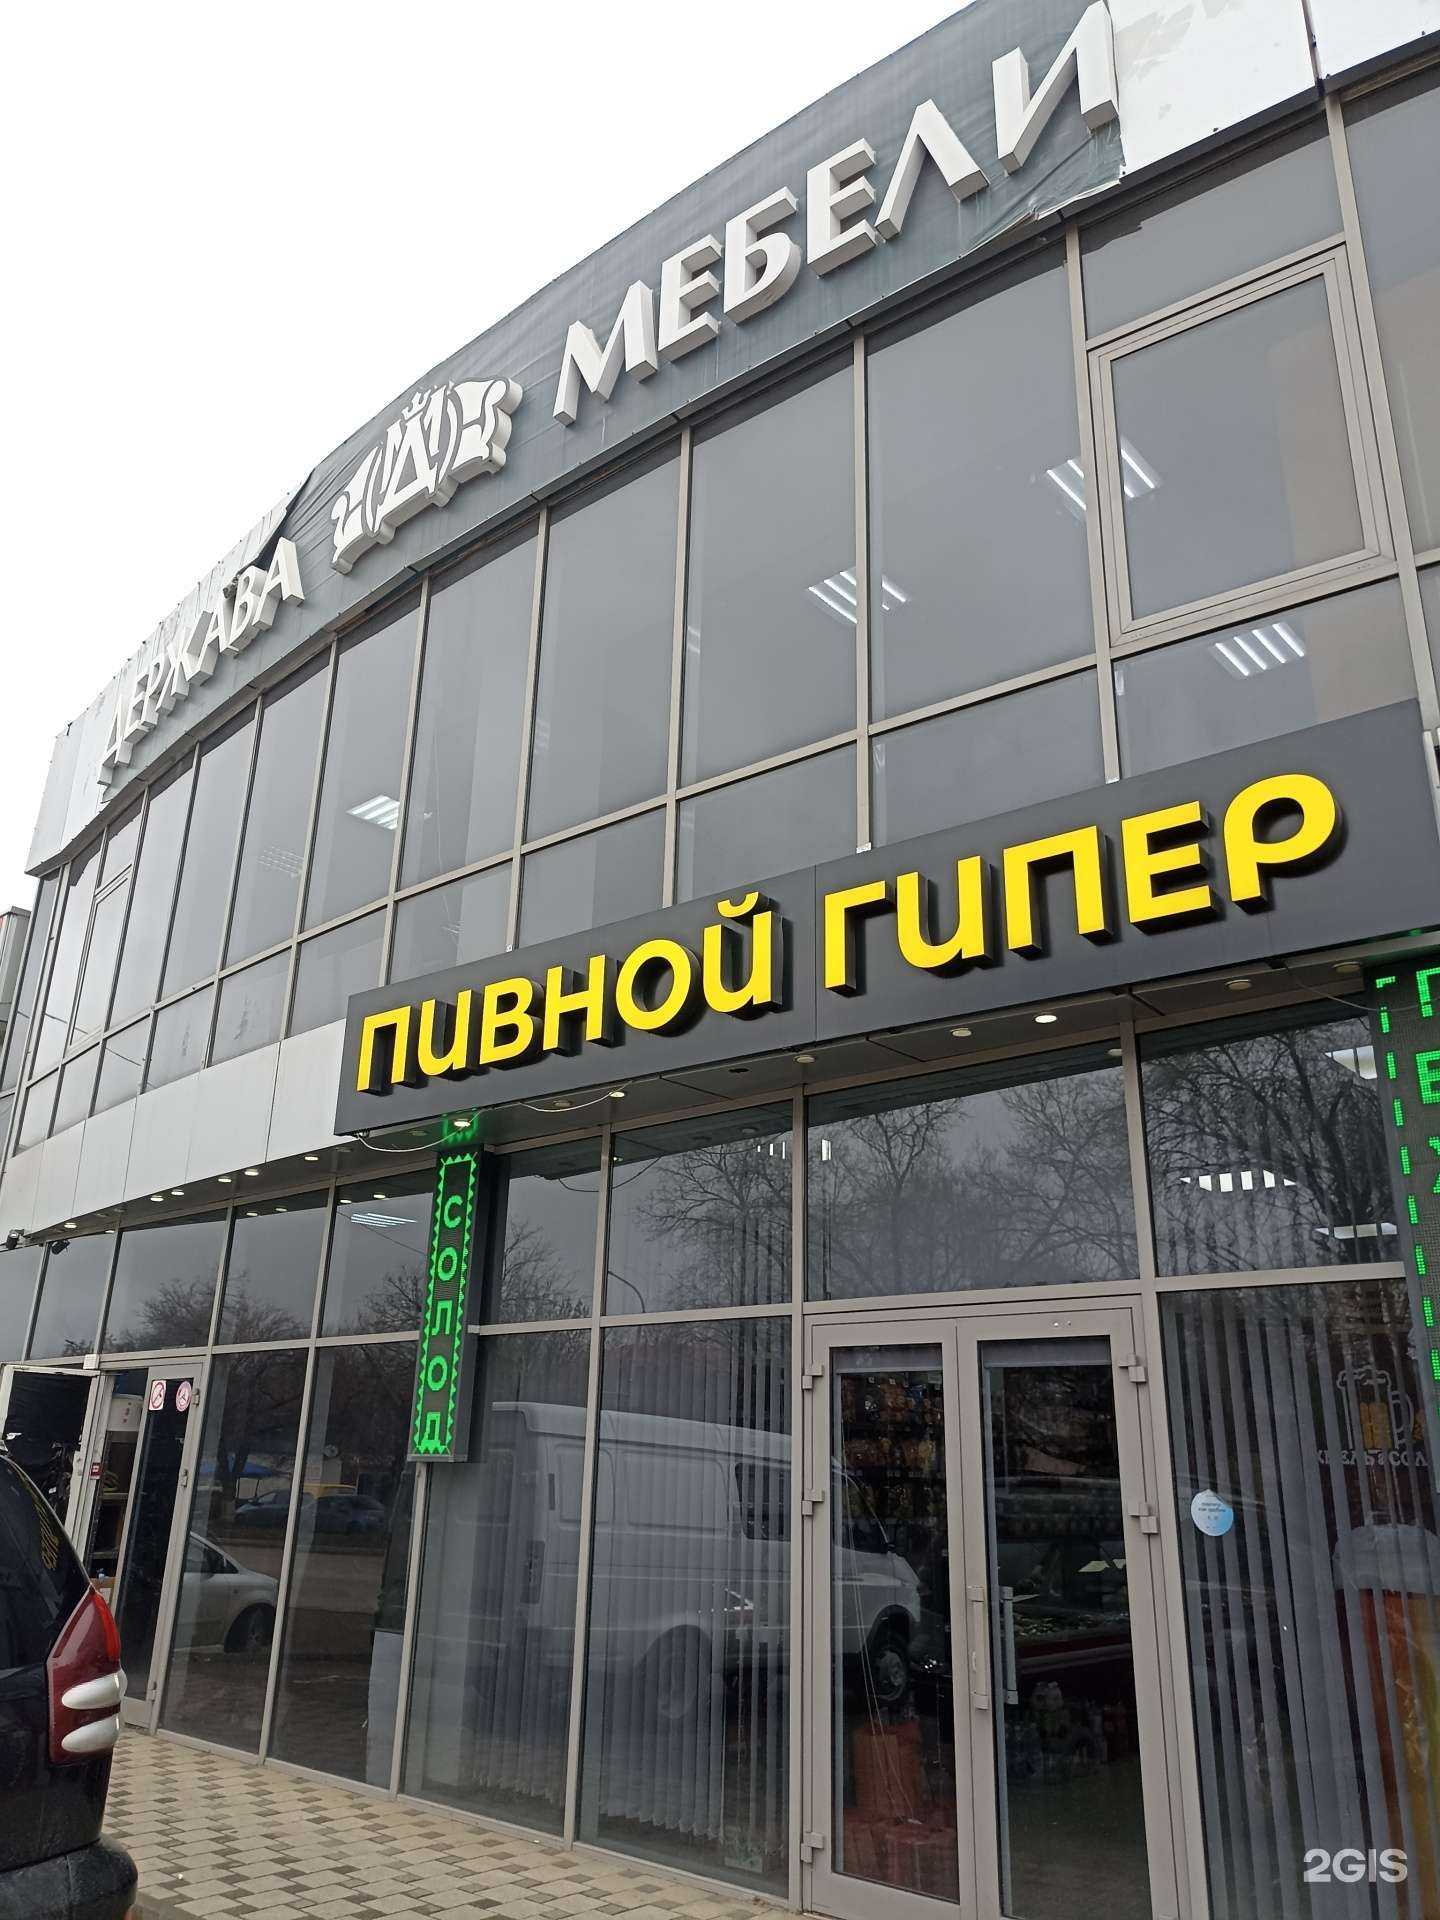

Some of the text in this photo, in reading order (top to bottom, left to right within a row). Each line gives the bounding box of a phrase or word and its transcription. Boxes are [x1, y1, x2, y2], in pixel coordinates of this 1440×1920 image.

[97, 536, 305, 787] ДЕРЖАВА
[553, 0, 1120, 426] МЕБЕЛИ
[356, 773, 1343, 1093] ПИВНОЙ ГИПЕР
[418, 1194, 464, 1451] СОЛОД
